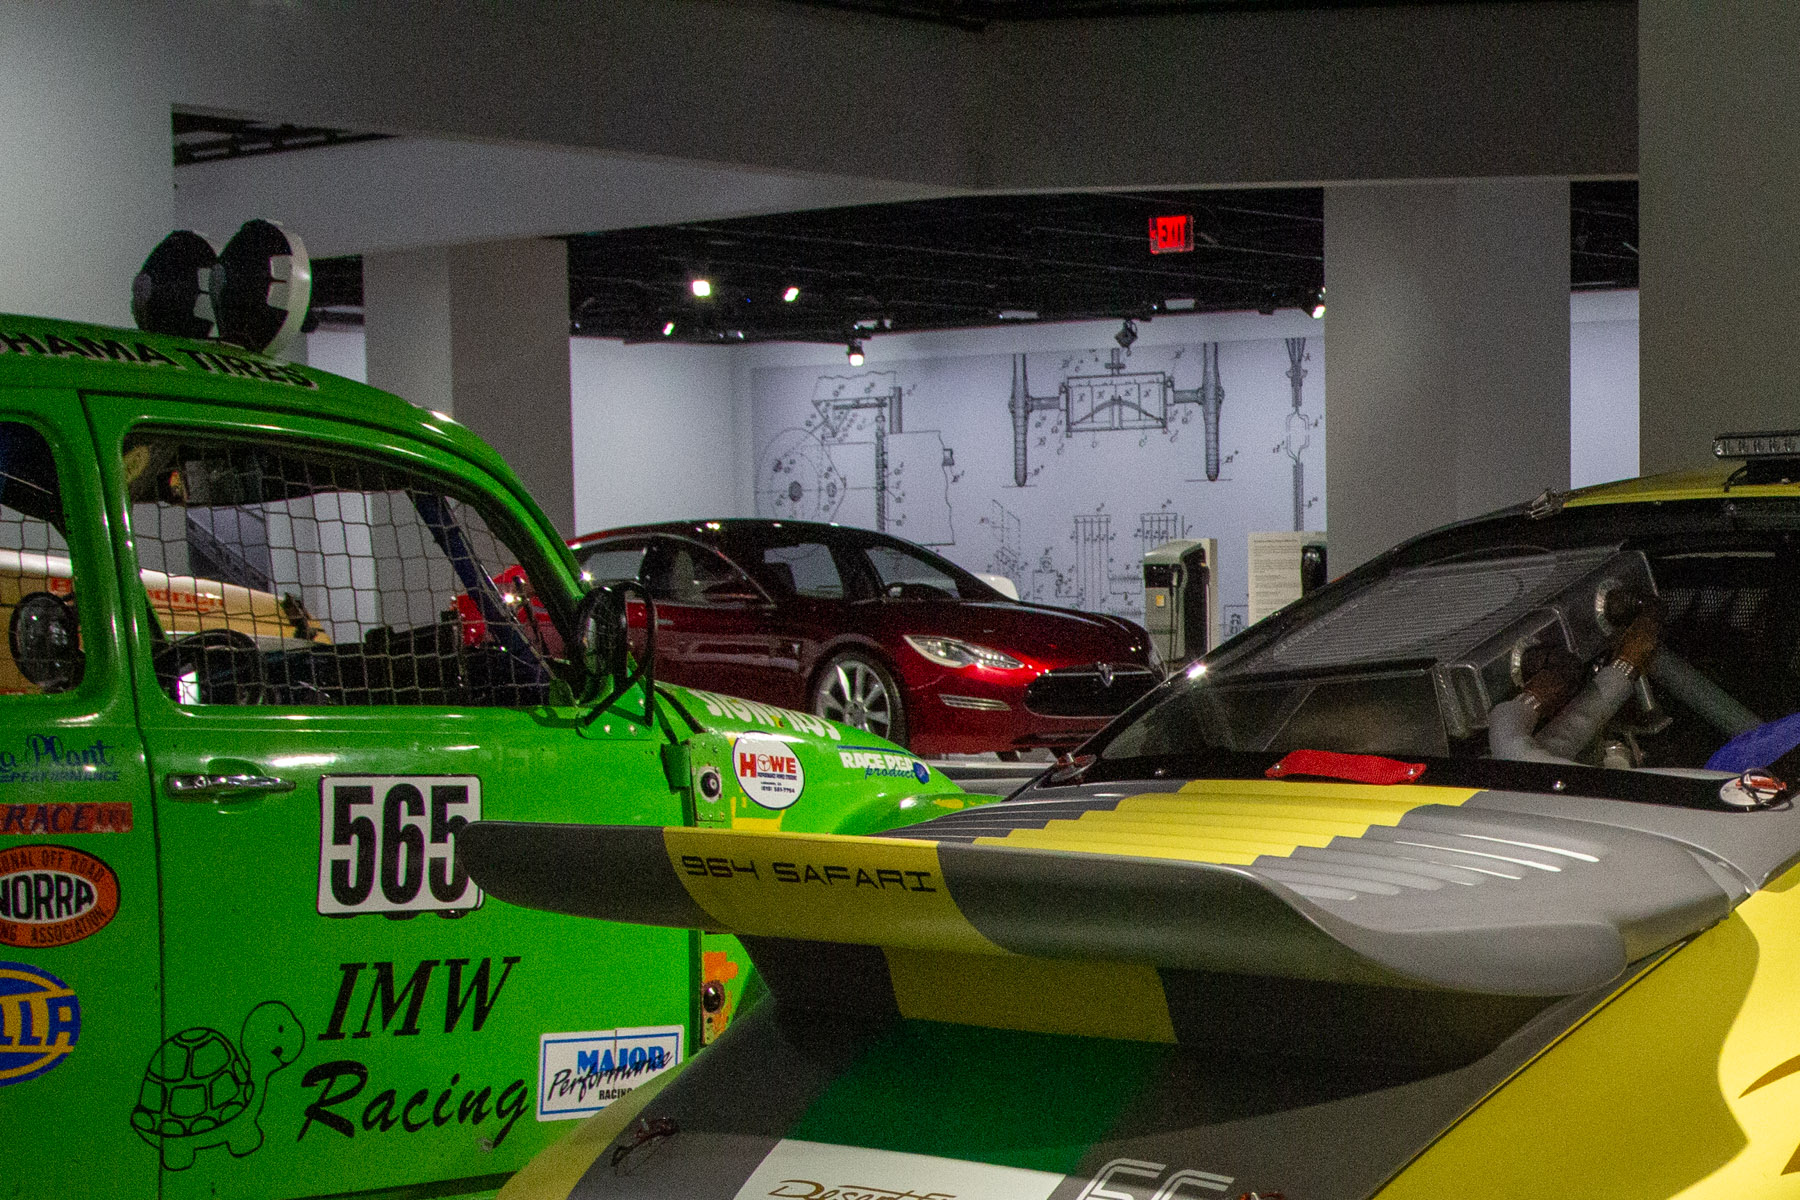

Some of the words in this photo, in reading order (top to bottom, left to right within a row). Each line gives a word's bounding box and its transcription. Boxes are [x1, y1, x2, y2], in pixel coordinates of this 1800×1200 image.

[176, 348, 319, 390] TIRES
[740, 753, 797, 778] HOWE
[839, 752, 886, 769] RACE
[865, 765, 916, 780] product
[3, 805, 94, 832] RACE
[330, 785, 470, 906] 565
[682, 855, 759, 881] 964
[773, 861, 937, 893] SAFARI
[318, 956, 521, 1041] IMW
[547, 1050, 673, 1102] Performance
[298, 1060, 528, 1148] Racing
